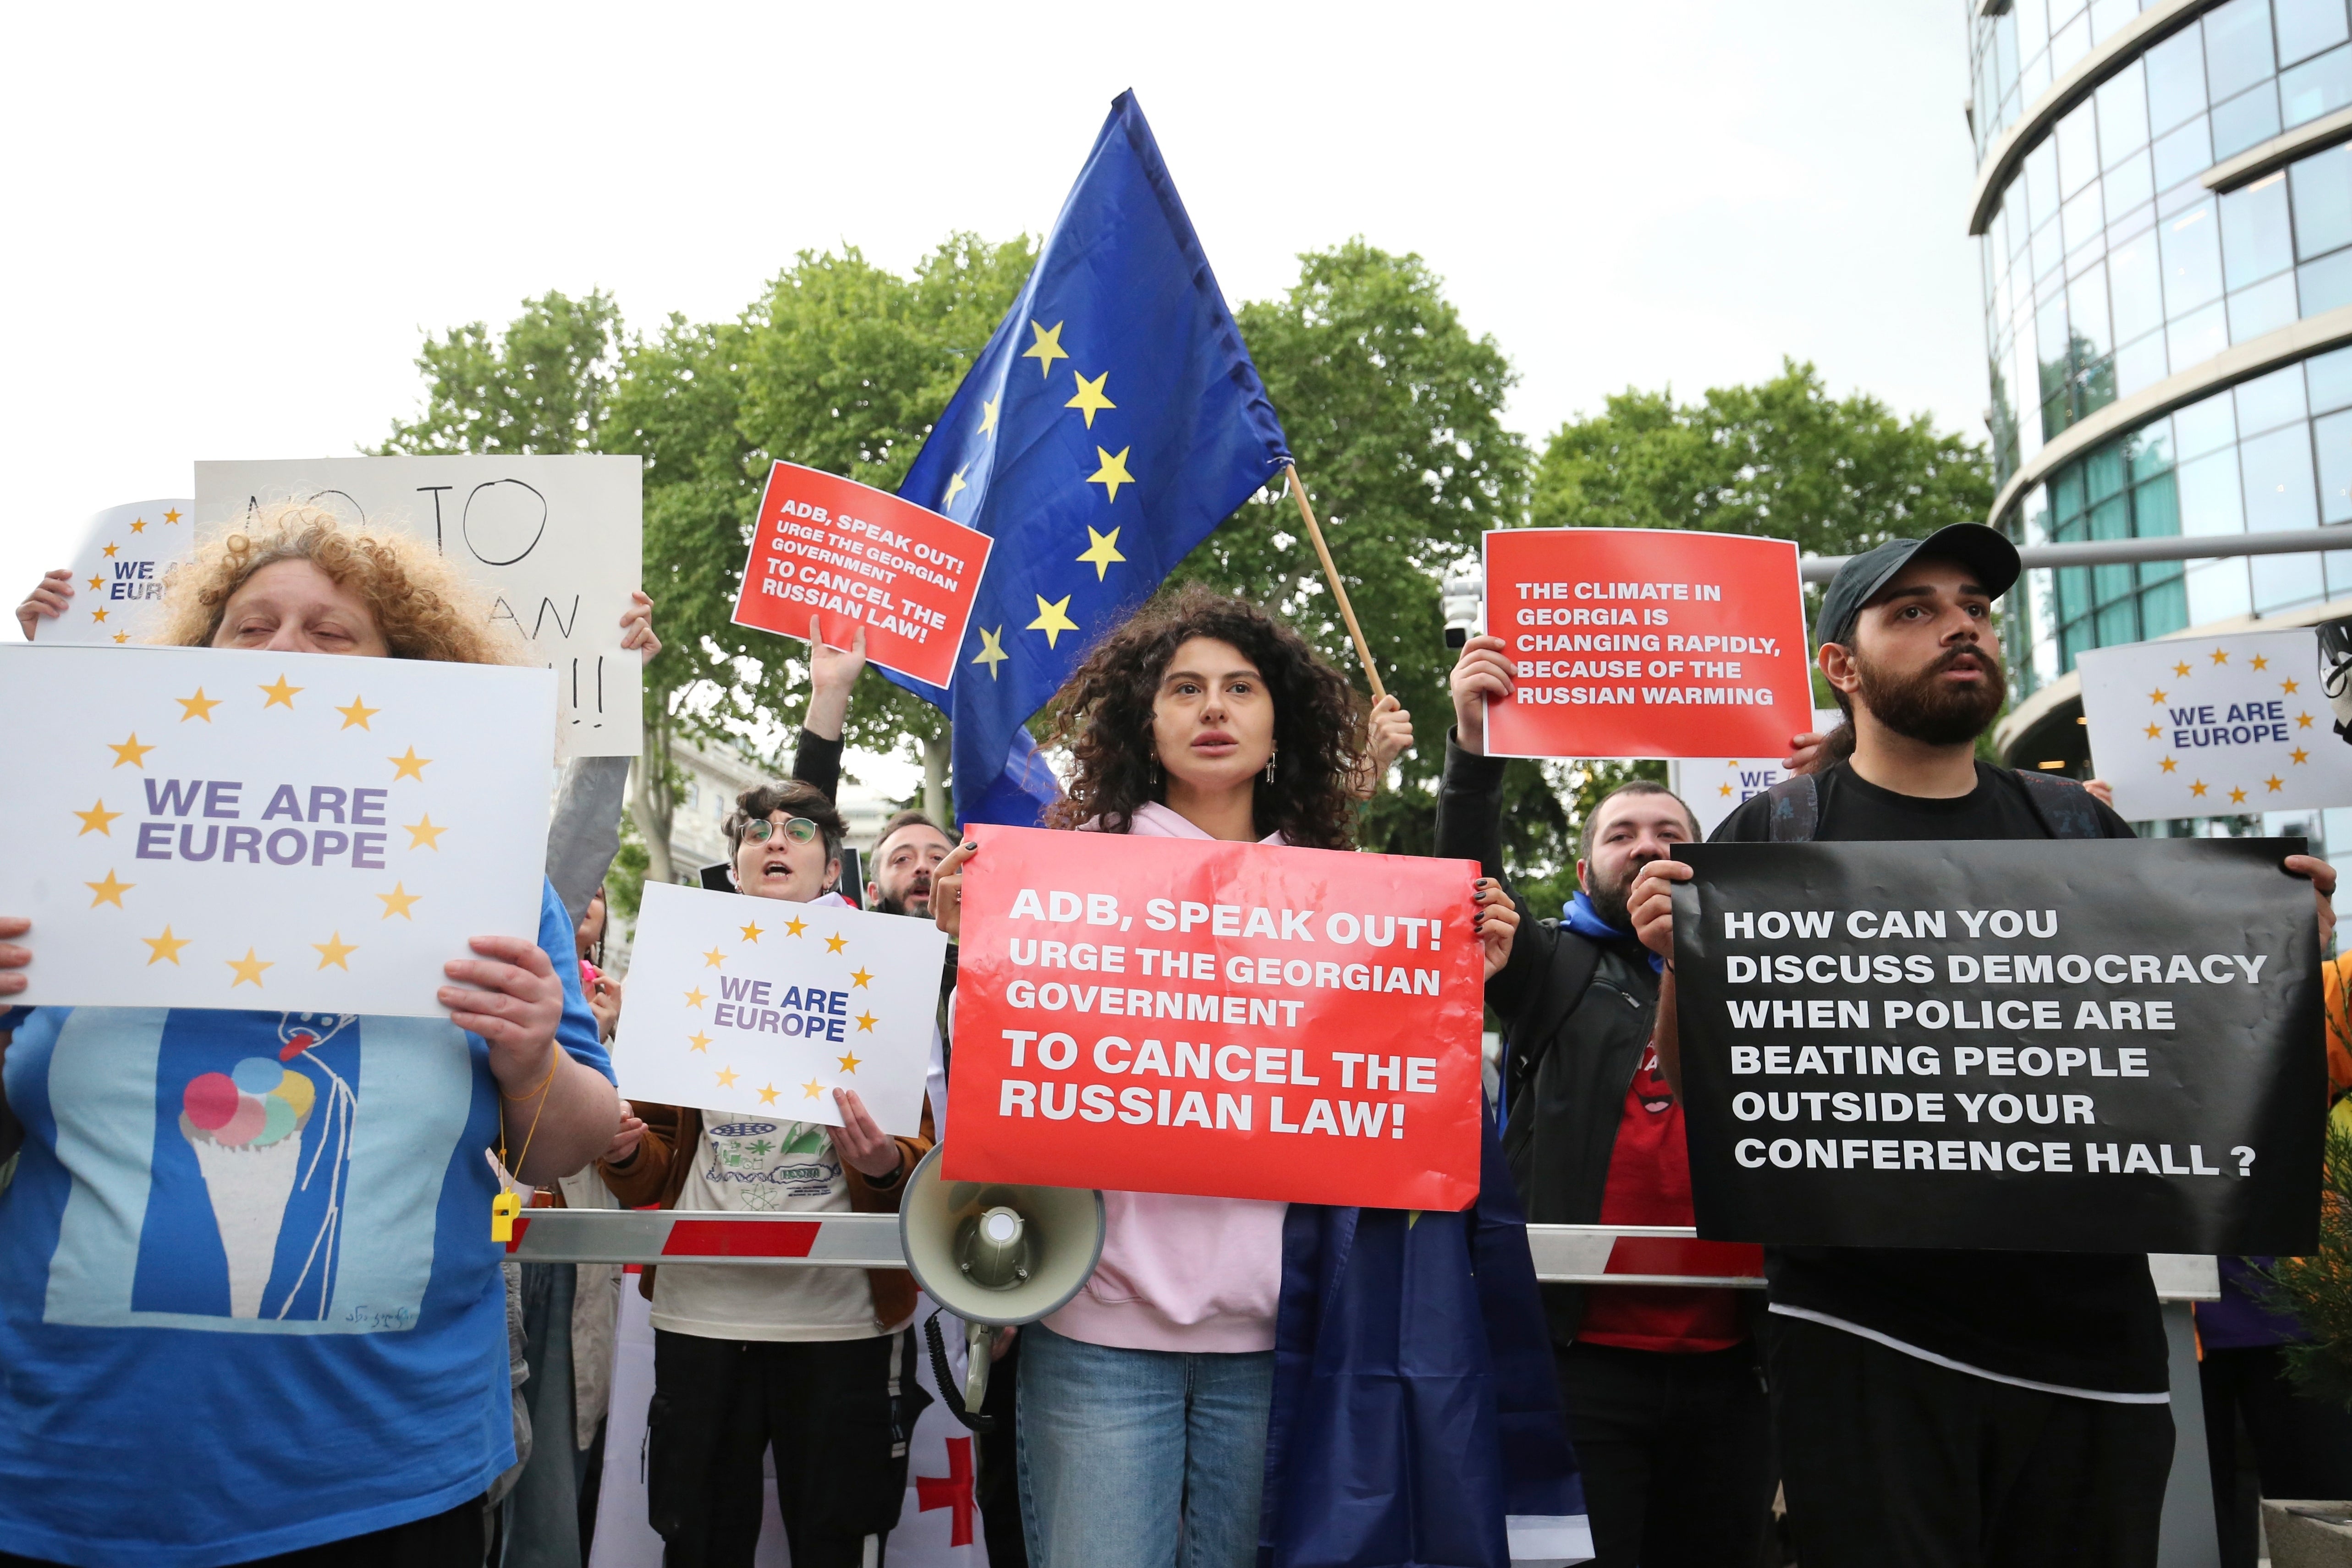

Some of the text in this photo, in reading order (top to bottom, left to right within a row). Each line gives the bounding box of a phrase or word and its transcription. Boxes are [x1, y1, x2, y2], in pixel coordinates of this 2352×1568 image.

[417, 478, 547, 566] TO
[781, 499, 965, 574] ADB, SPEAK OUT!
[115, 561, 154, 580] WE
[772, 537, 896, 584] GOVERNMENT
[776, 520, 958, 592] URGE THE GEORGIAN
[110, 582, 166, 600] EUR
[767, 558, 946, 630] TO CANCEL THE
[1517, 582, 1720, 601] THE CLIMATE IN
[762, 578, 928, 644] RUSSIAN LAW!
[1517, 609, 1668, 625] GEORGIA IS
[1517, 635, 1780, 657] CHANGING RAPIDLY,
[1518, 661, 1741, 679] BECAUSE OF THE
[1517, 687, 1773, 705] RUSSIAN WARMING
[2170, 700, 2286, 726] WE ARE
[2173, 723, 2289, 748] EUROPE
[1740, 771, 1777, 787] WE
[143, 778, 388, 826] WE ARE
[136, 822, 387, 869] EUROPE
[1009, 889, 1441, 951] ADB, SPEAK OUT!
[1725, 910, 2058, 939] HOW CAN YOU
[1009, 938, 1440, 996] URGE THE GEORGIAN
[1726, 954, 2267, 983] DISCUSS DEMOCRACY
[720, 976, 849, 1015] WE ARE
[1006, 980, 1304, 1027] GOVERNMENT
[714, 1003, 846, 1042] EUROPE
[1727, 1000, 2175, 1030] WHEN POLICE ARE
[1002, 1030, 1437, 1092] TO CANCEL THE
[1731, 1046, 2149, 1077] BEATING PEOPLE
[1000, 1080, 1405, 1139] RUSSIAN LAW!
[1732, 1091, 2094, 1124] OUTSIDE YOUR
[1735, 1139, 2255, 1177] CONFERENCE HALL ?
